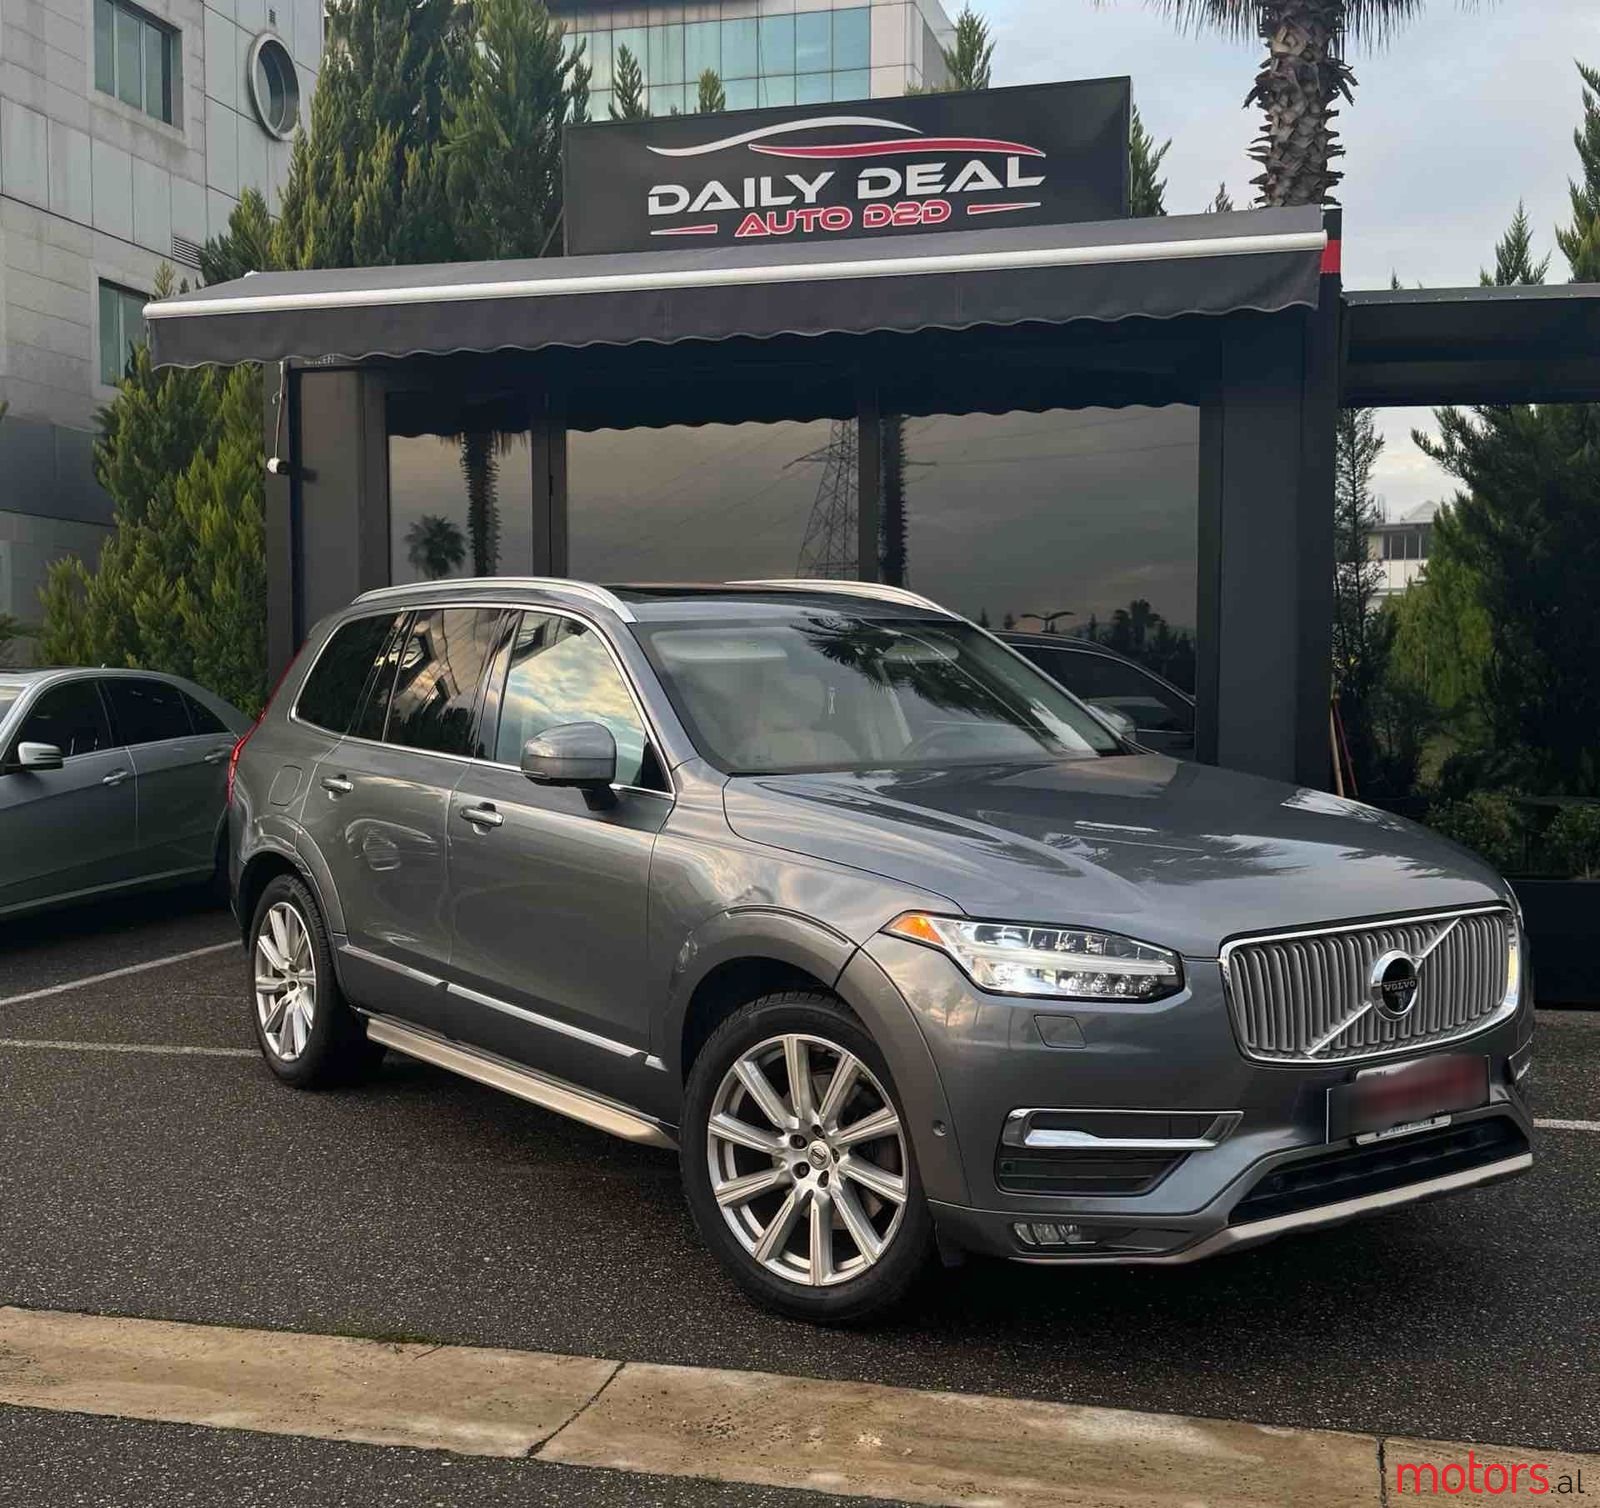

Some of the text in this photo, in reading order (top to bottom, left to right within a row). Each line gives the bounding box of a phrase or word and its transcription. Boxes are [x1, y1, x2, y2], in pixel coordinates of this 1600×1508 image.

[648, 157, 1046, 215] DAILY DEAL
[734, 200, 951, 237] AUTO D2D
[1383, 980, 1416, 992] VOLVO
